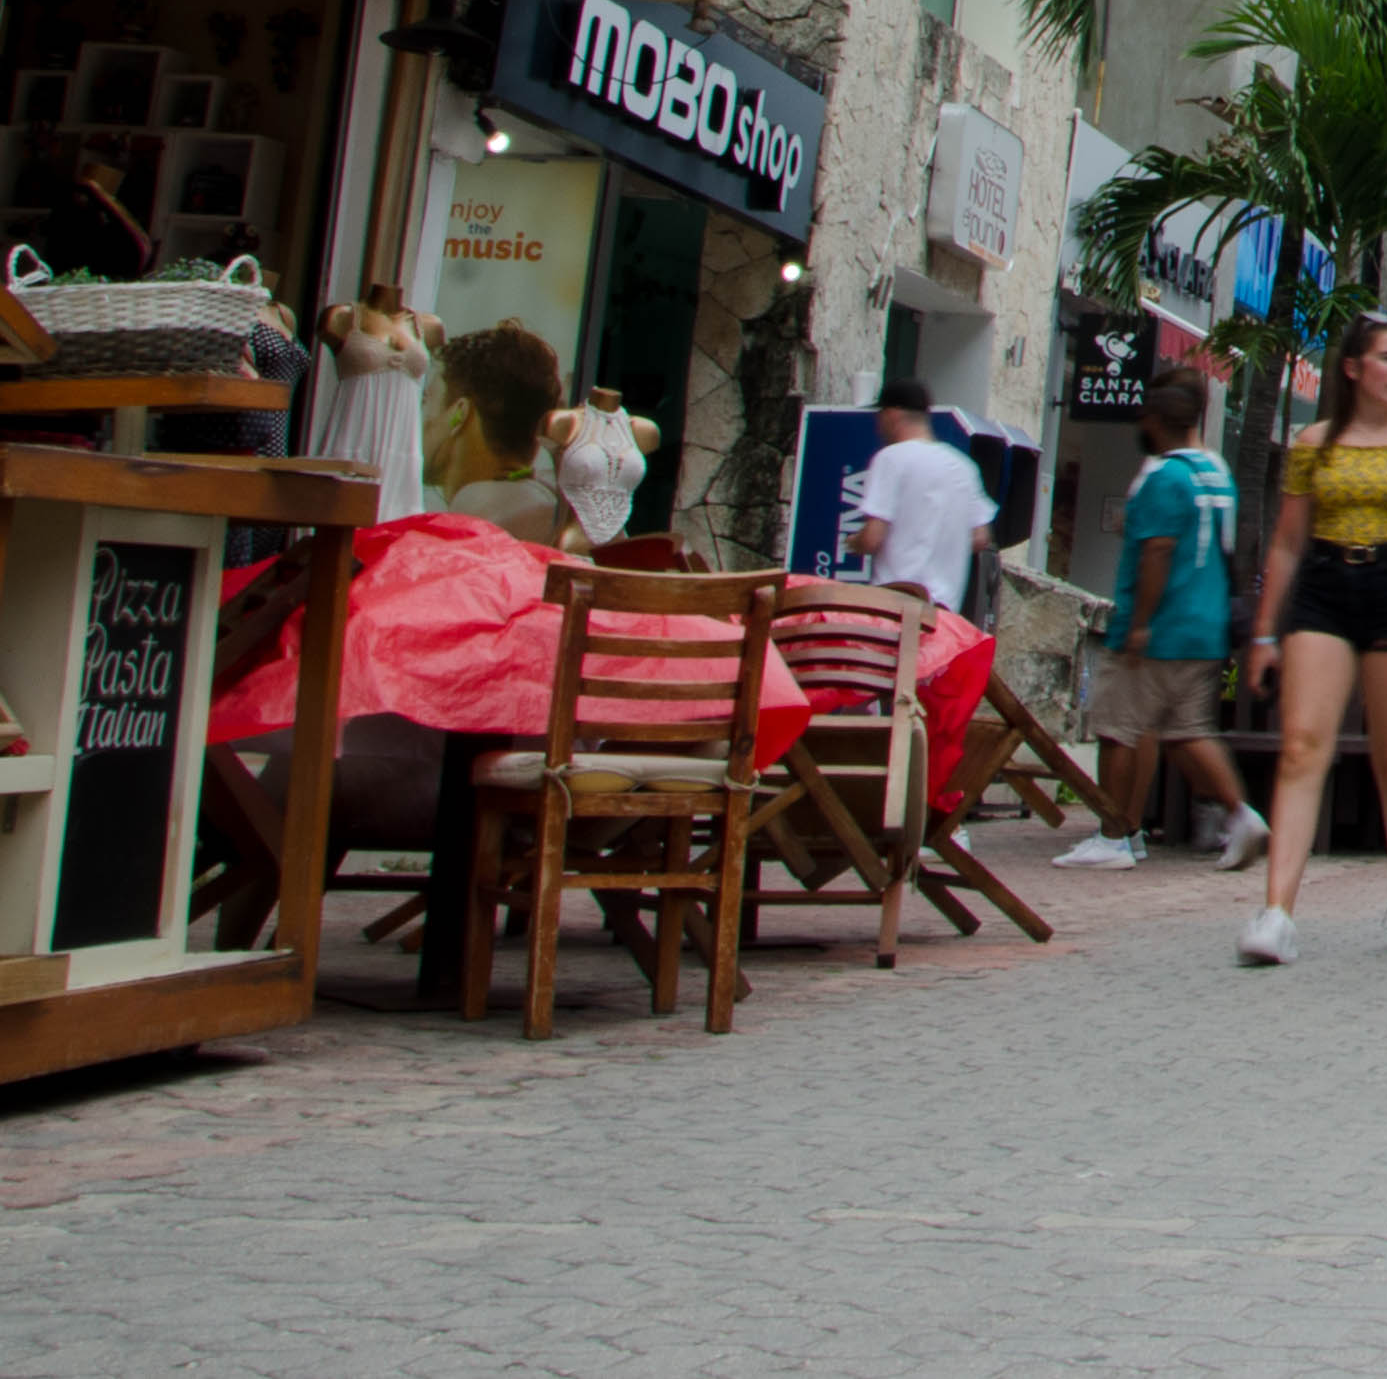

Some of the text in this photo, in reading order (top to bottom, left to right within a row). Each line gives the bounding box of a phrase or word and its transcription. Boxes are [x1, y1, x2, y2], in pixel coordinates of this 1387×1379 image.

[734, 89, 804, 212] shop
[450, 198, 504, 224] njoy
[968, 169, 1007, 223] HOTEL
[443, 232, 544, 262] music
[468, 223, 492, 235] the
[1079, 391, 1143, 407] CLARA
[1081, 377, 1144, 392] SANTA
[90, 546, 183, 624] Pizza
[80, 620, 173, 699] Pasta
[73, 700, 167, 756] Italian
